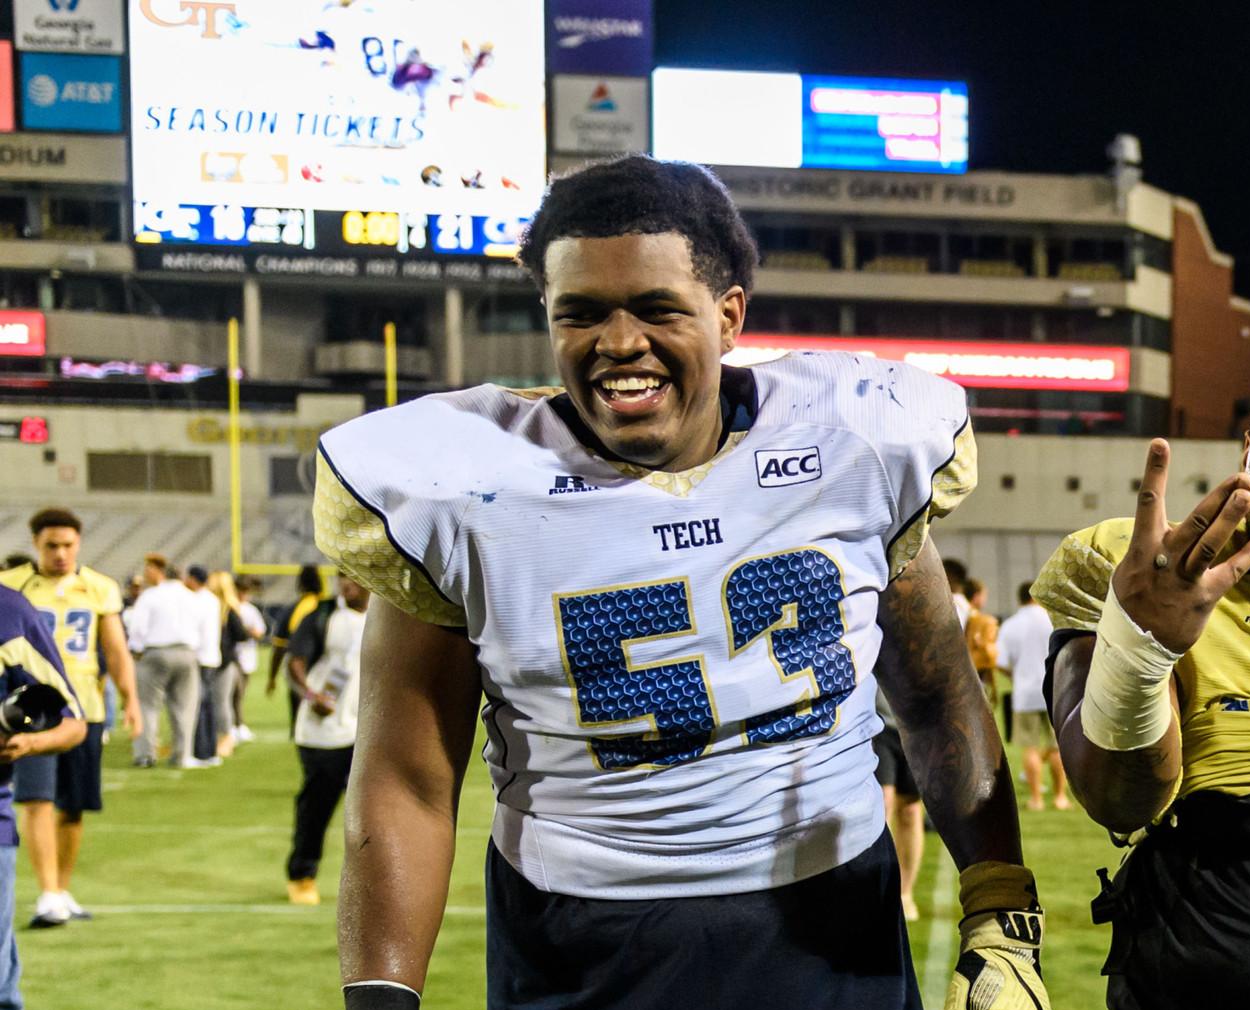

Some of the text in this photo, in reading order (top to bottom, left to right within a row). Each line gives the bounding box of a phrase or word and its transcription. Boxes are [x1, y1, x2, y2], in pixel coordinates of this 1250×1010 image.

[61, 81, 115, 104] AT&T
[145, 106, 424, 141] SEASON TICKETS
[943, 180, 1016, 205] FIELD
[163, 252, 246, 274] NATIONAL
[255, 254, 359, 277] CHAMPIONS
[761, 454, 818, 479] ACC
[653, 518, 723, 551] TECH
[552, 546, 857, 771] 53
